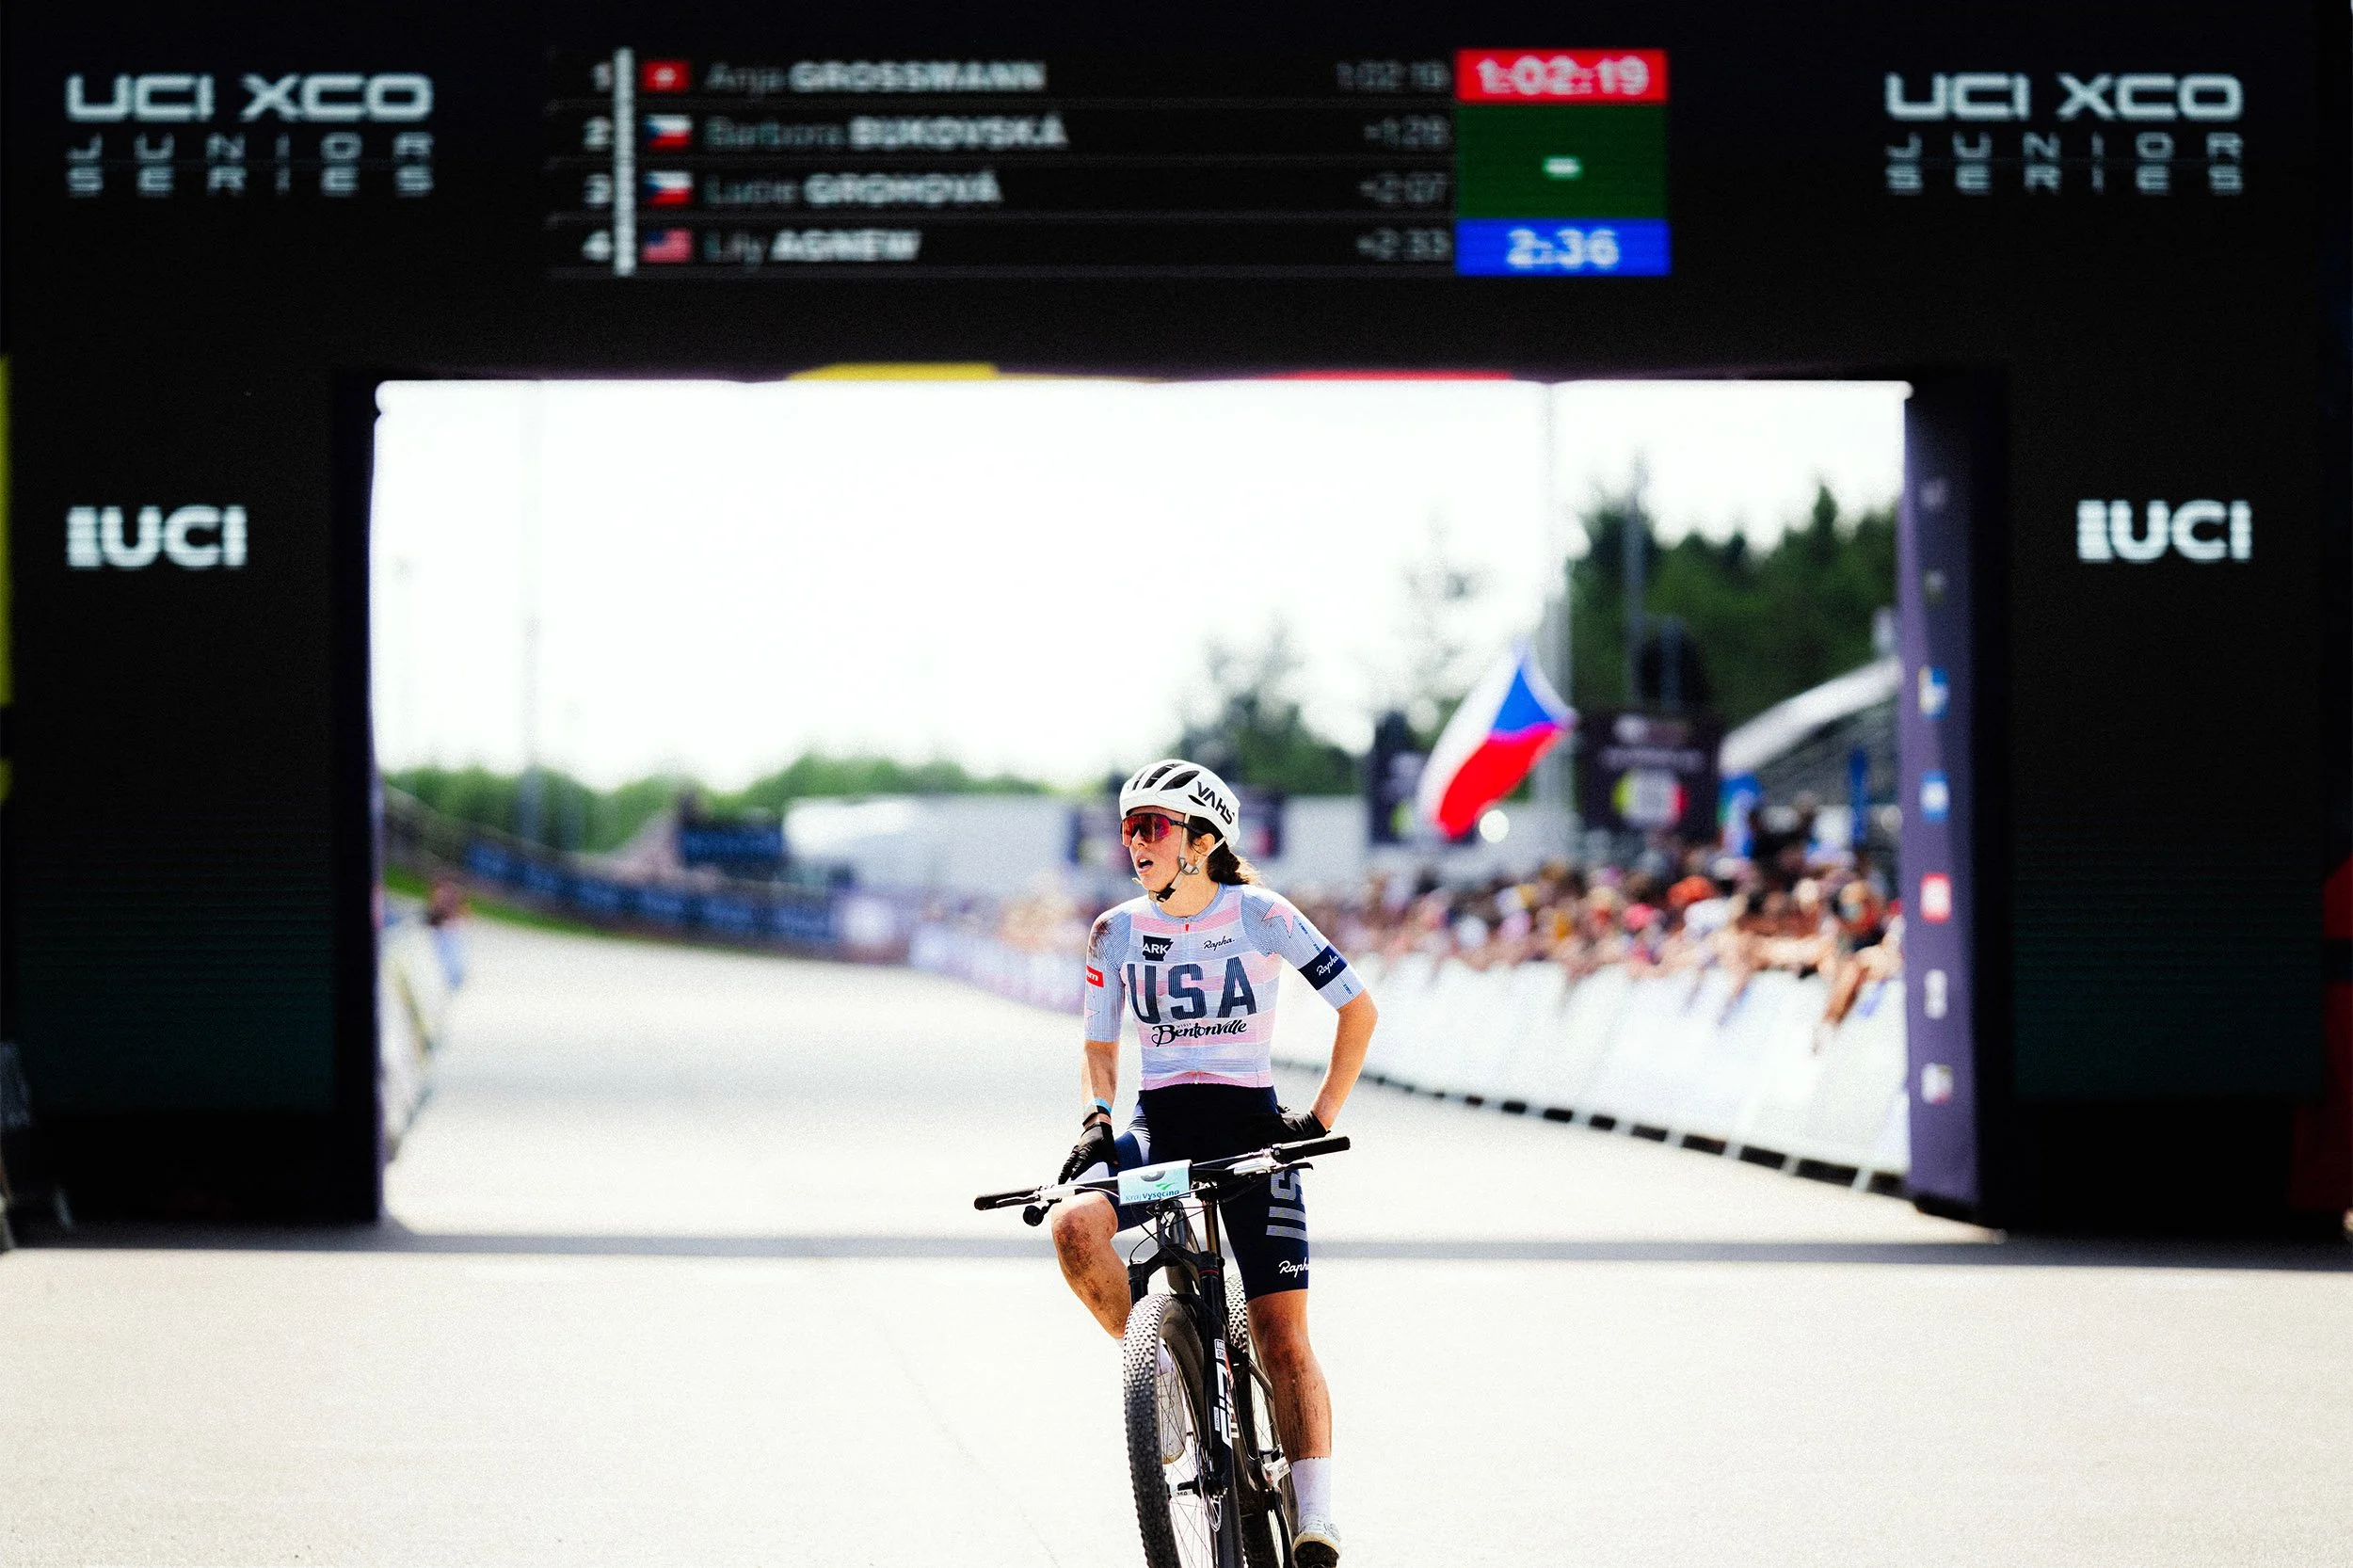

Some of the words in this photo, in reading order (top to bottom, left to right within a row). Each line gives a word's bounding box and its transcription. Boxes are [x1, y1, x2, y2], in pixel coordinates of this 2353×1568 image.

[1477, 55, 1650, 96] 1:02:19
[66, 72, 216, 122] UCI
[241, 72, 434, 122] XCO
[1885, 72, 2031, 120] UCI
[2057, 72, 2244, 120] XCO
[66, 131, 434, 161] JUNIOR
[584, 115, 611, 150] 2
[1885, 131, 2243, 161] JUNIOR
[66, 165, 434, 196] SERIES
[1885, 164, 2243, 195] SERIES
[583, 231, 611, 262] 4
[770, 229, 921, 262] AGNEW
[1507, 228, 1620, 268] 2:36
[1142, 942, 1169, 954] ARK
[1127, 956, 1257, 1024] USA
[1151, 1019, 1247, 1048] Bentonville
[1278, 1256, 1309, 1278] Raph
